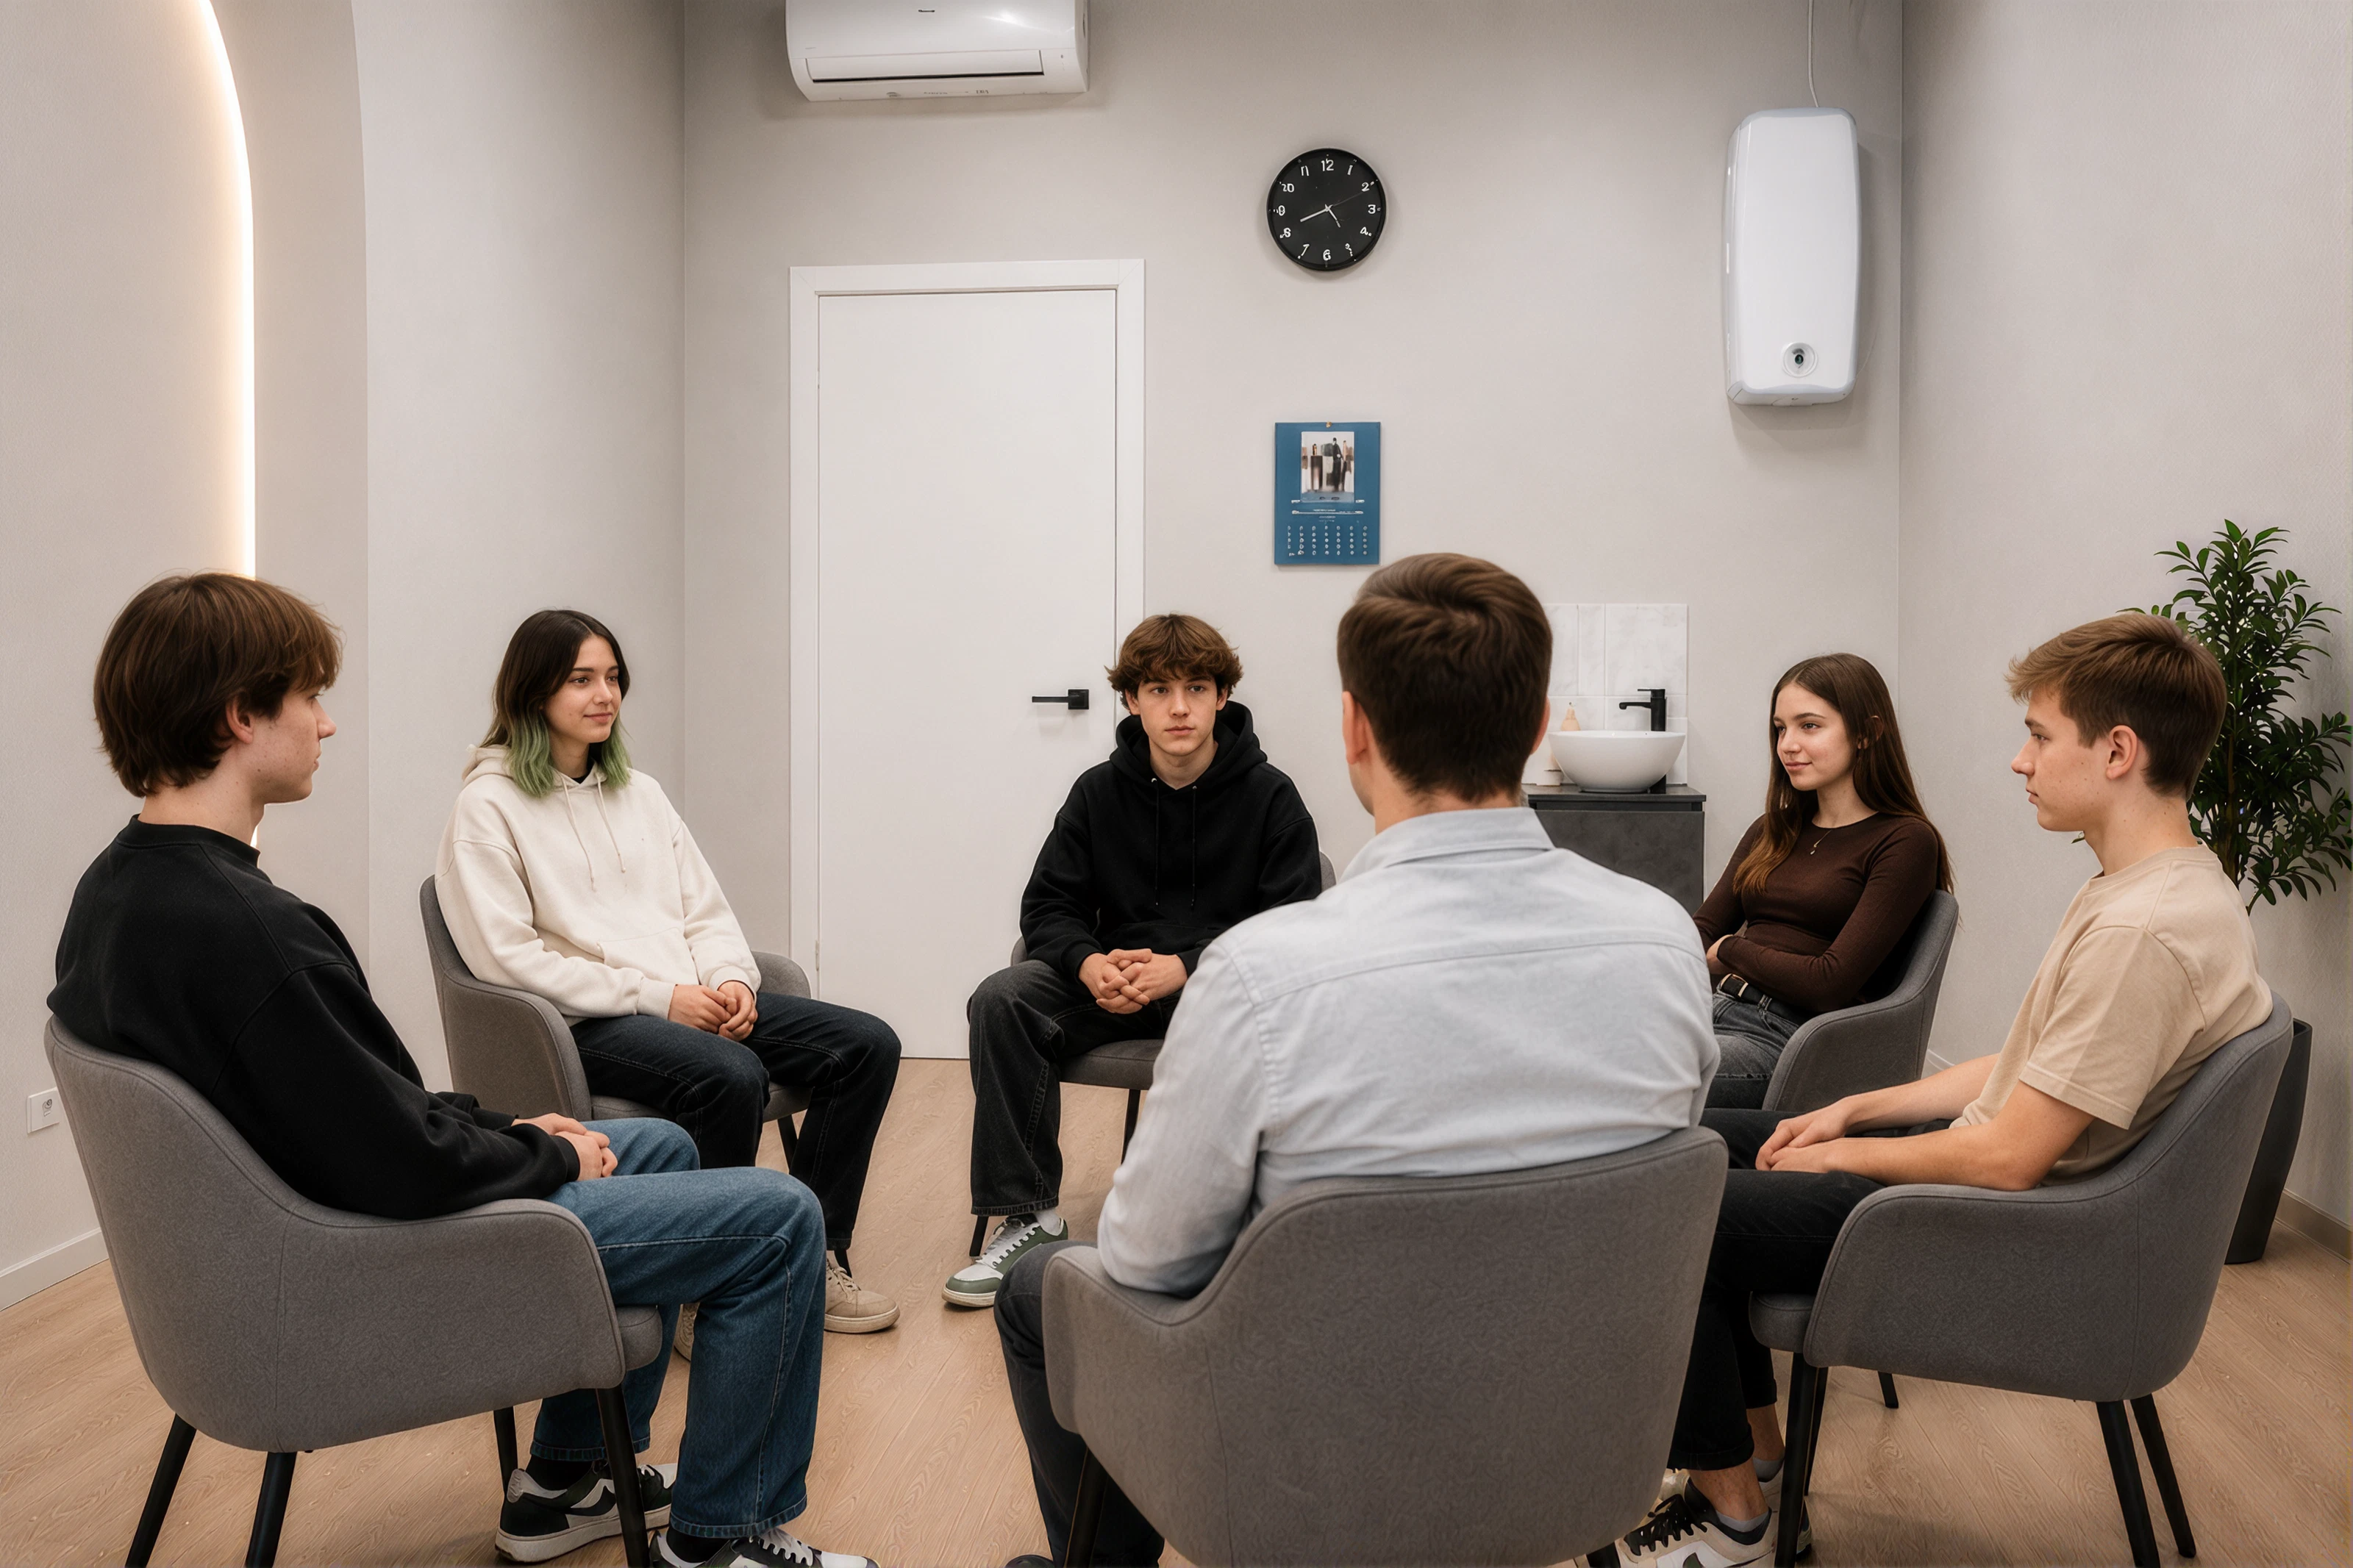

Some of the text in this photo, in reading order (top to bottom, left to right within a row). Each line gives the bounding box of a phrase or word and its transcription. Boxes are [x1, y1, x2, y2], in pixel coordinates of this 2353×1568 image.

[1321, 158, 1334, 171] 12
[1361, 182, 1370, 192] 2
[1368, 204, 1376, 214] 3
